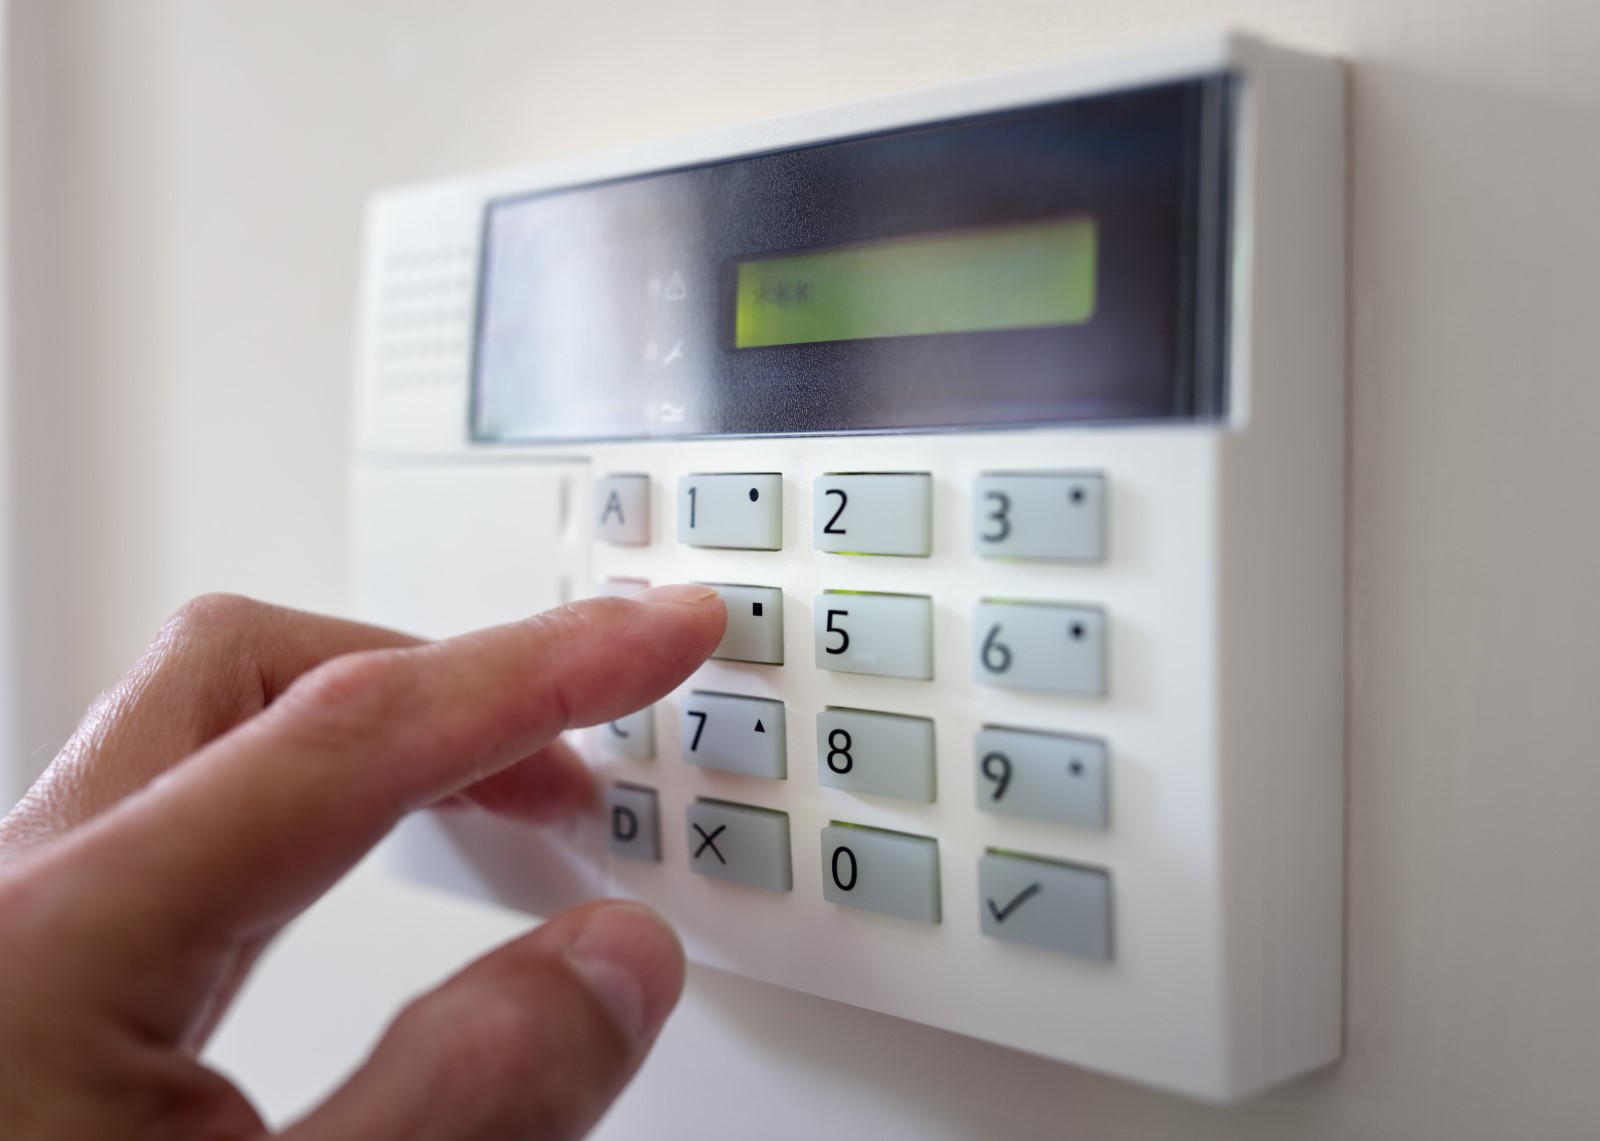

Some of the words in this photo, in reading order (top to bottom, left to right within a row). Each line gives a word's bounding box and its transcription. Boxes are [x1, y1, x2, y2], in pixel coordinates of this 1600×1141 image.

[601, 492, 625, 525] A
[687, 487, 697, 529] 1
[824, 489, 849, 534] 2
[982, 491, 1011, 543] 3
[826, 610, 850, 655] 5
[981, 624, 1012, 673] 6
[687, 711, 707, 752] 7
[826, 729, 853, 775] 8
[981, 752, 1012, 801] 9
[613, 806, 637, 842] D
[831, 846, 858, 891] 0
